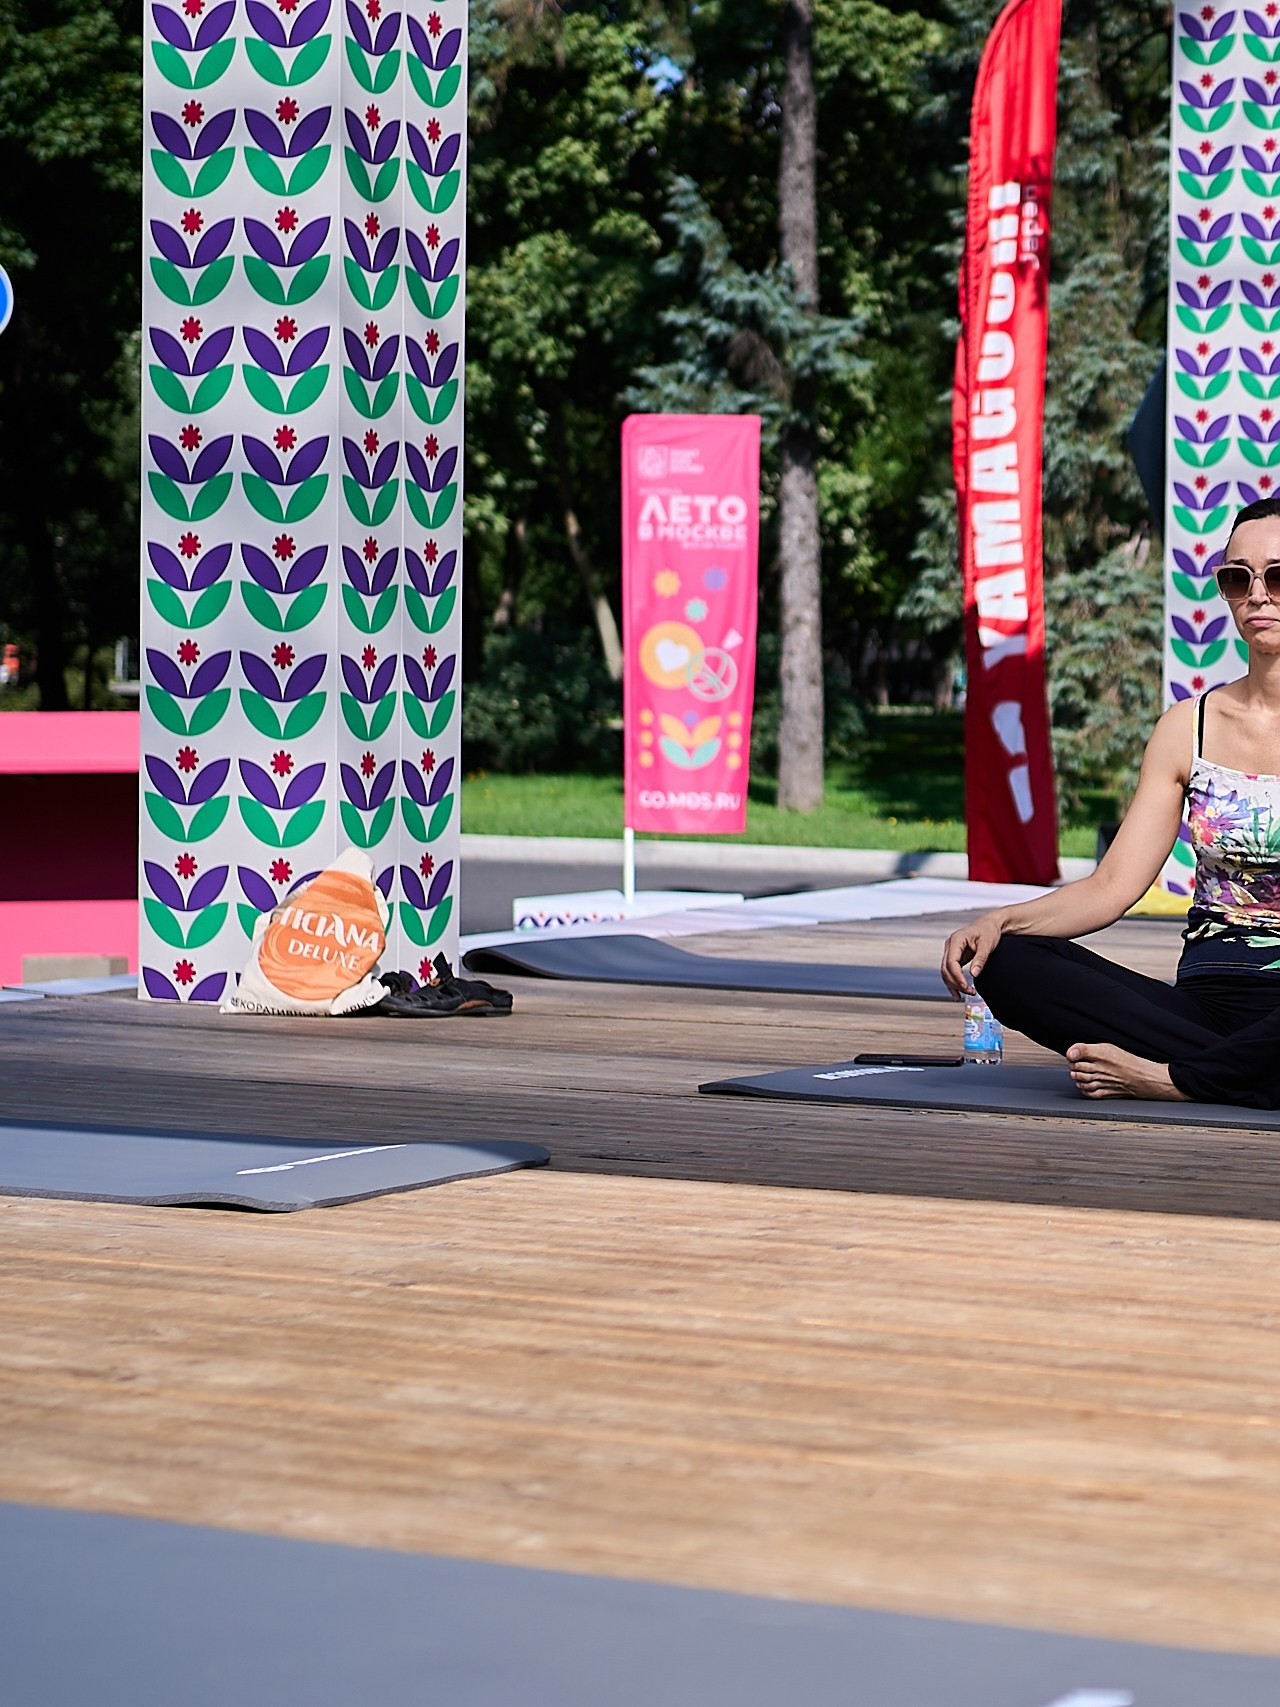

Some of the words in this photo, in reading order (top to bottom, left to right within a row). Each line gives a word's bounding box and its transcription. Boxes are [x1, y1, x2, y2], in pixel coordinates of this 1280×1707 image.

[1019, 184, 1044, 271] Japan
[639, 494, 748, 524] ЛЕТО
[638, 524, 653, 541] В
[656, 523, 748, 541] МОСКВЕ
[279, 906, 380, 954] TICIANA
[287, 938, 360, 971] DELUXE
